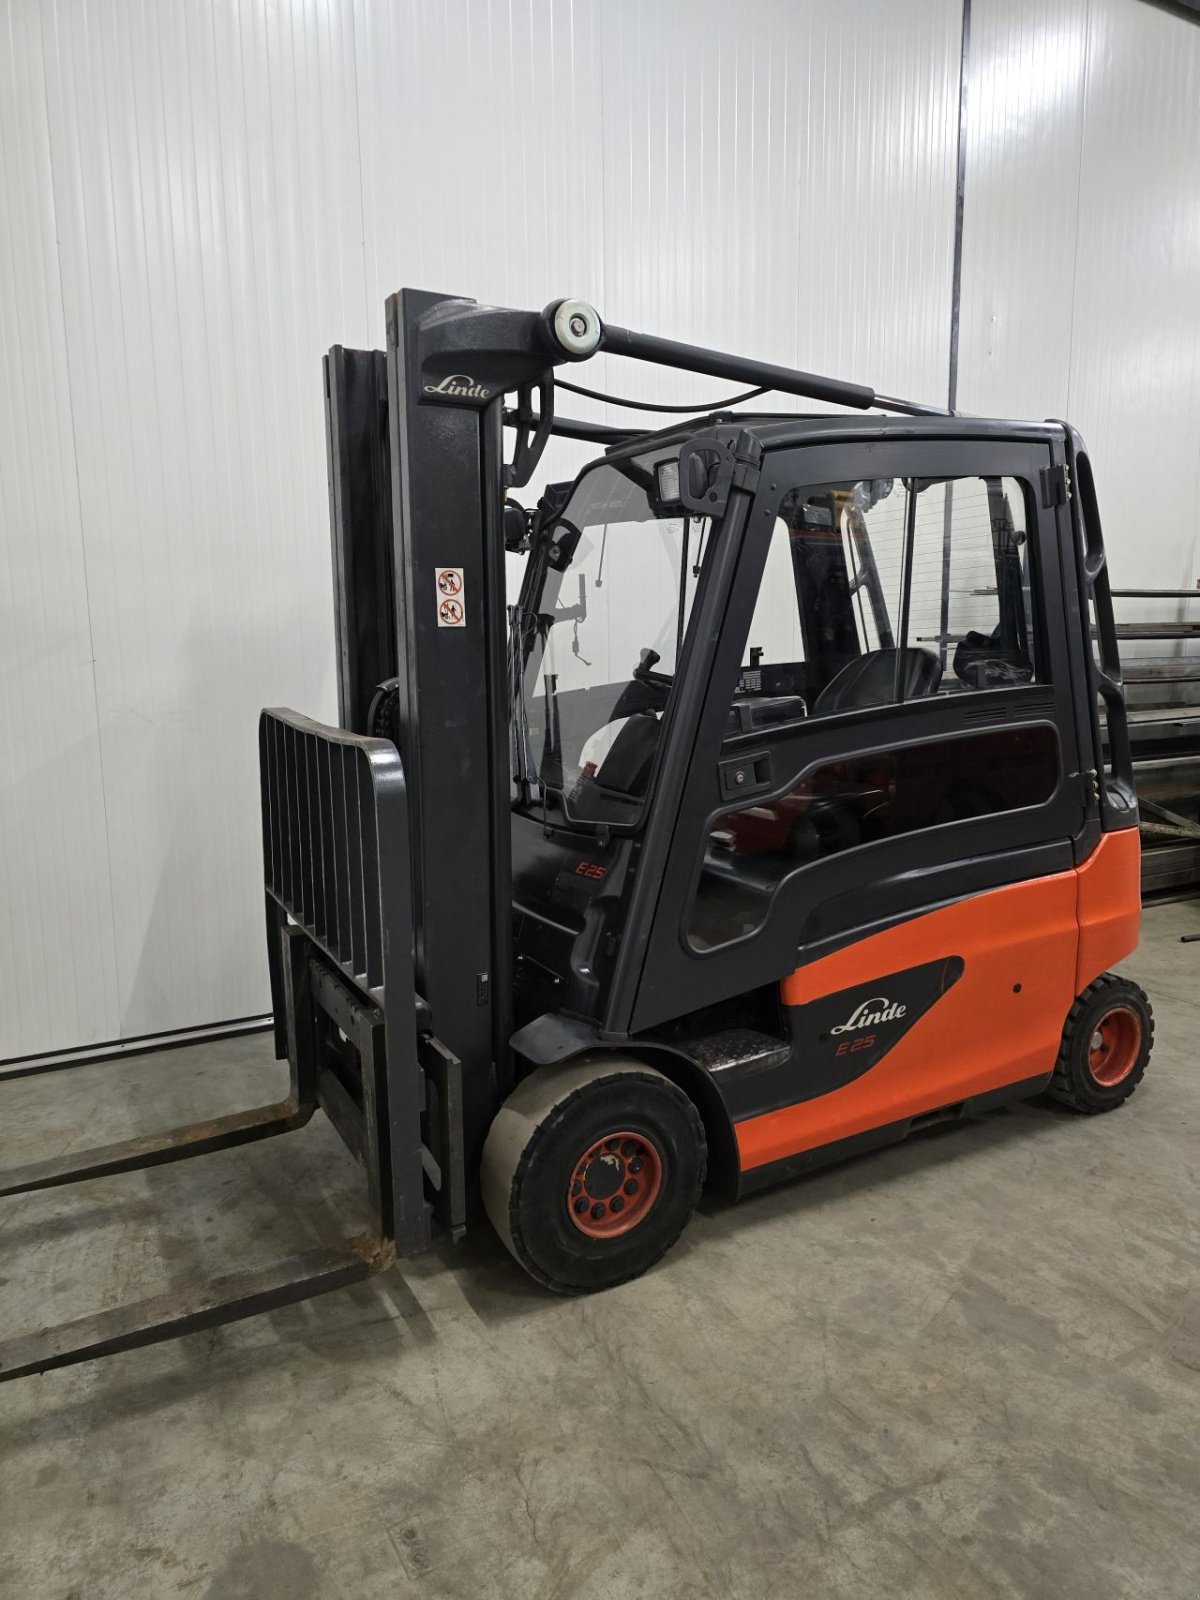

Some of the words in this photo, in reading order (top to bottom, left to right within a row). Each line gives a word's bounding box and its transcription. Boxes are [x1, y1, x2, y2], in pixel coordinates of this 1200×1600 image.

[424, 374, 490, 398] Linde
[575, 861, 608, 880] E25
[830, 997, 907, 1035] Linde
